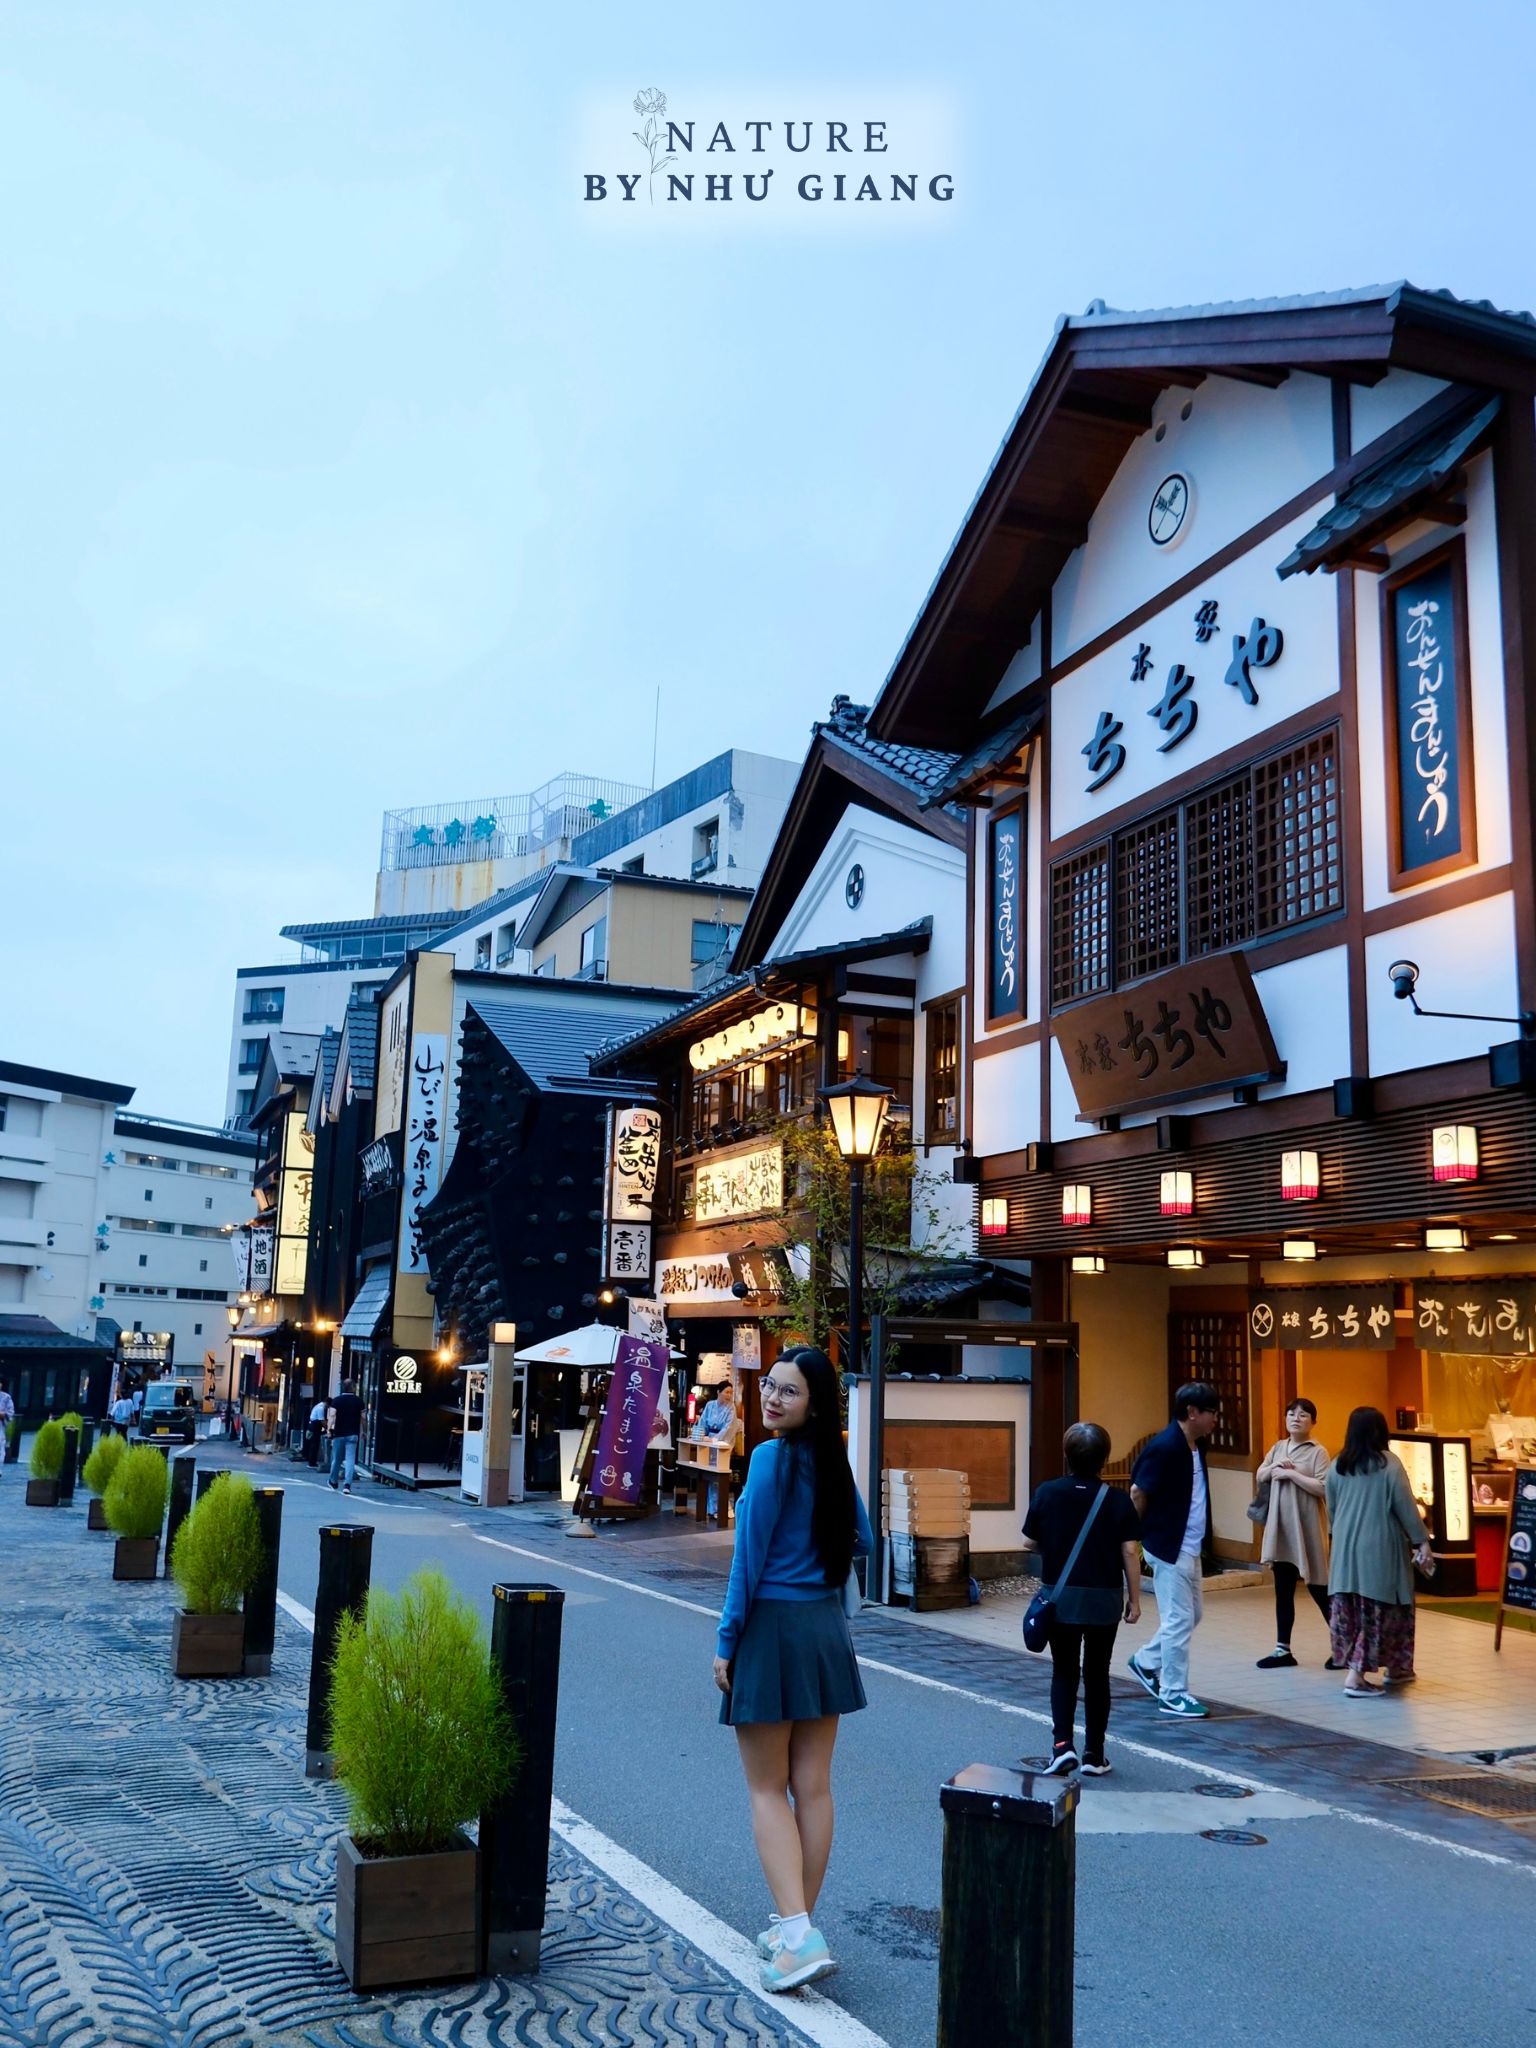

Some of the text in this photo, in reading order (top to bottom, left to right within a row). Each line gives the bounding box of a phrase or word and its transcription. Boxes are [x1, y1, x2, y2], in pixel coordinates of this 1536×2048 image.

[1081, 616, 1284, 793] ちちや
[254, 1239, 267, 1275] 地酒
[613, 1230, 634, 1272] 壱番
[635, 1230, 648, 1273] らーめん
[1418, 1298, 1536, 1341] おんせんまん
[386, 1381, 422, 1391] TIGRE
[613, 1346, 661, 1455] 温泉たまご
